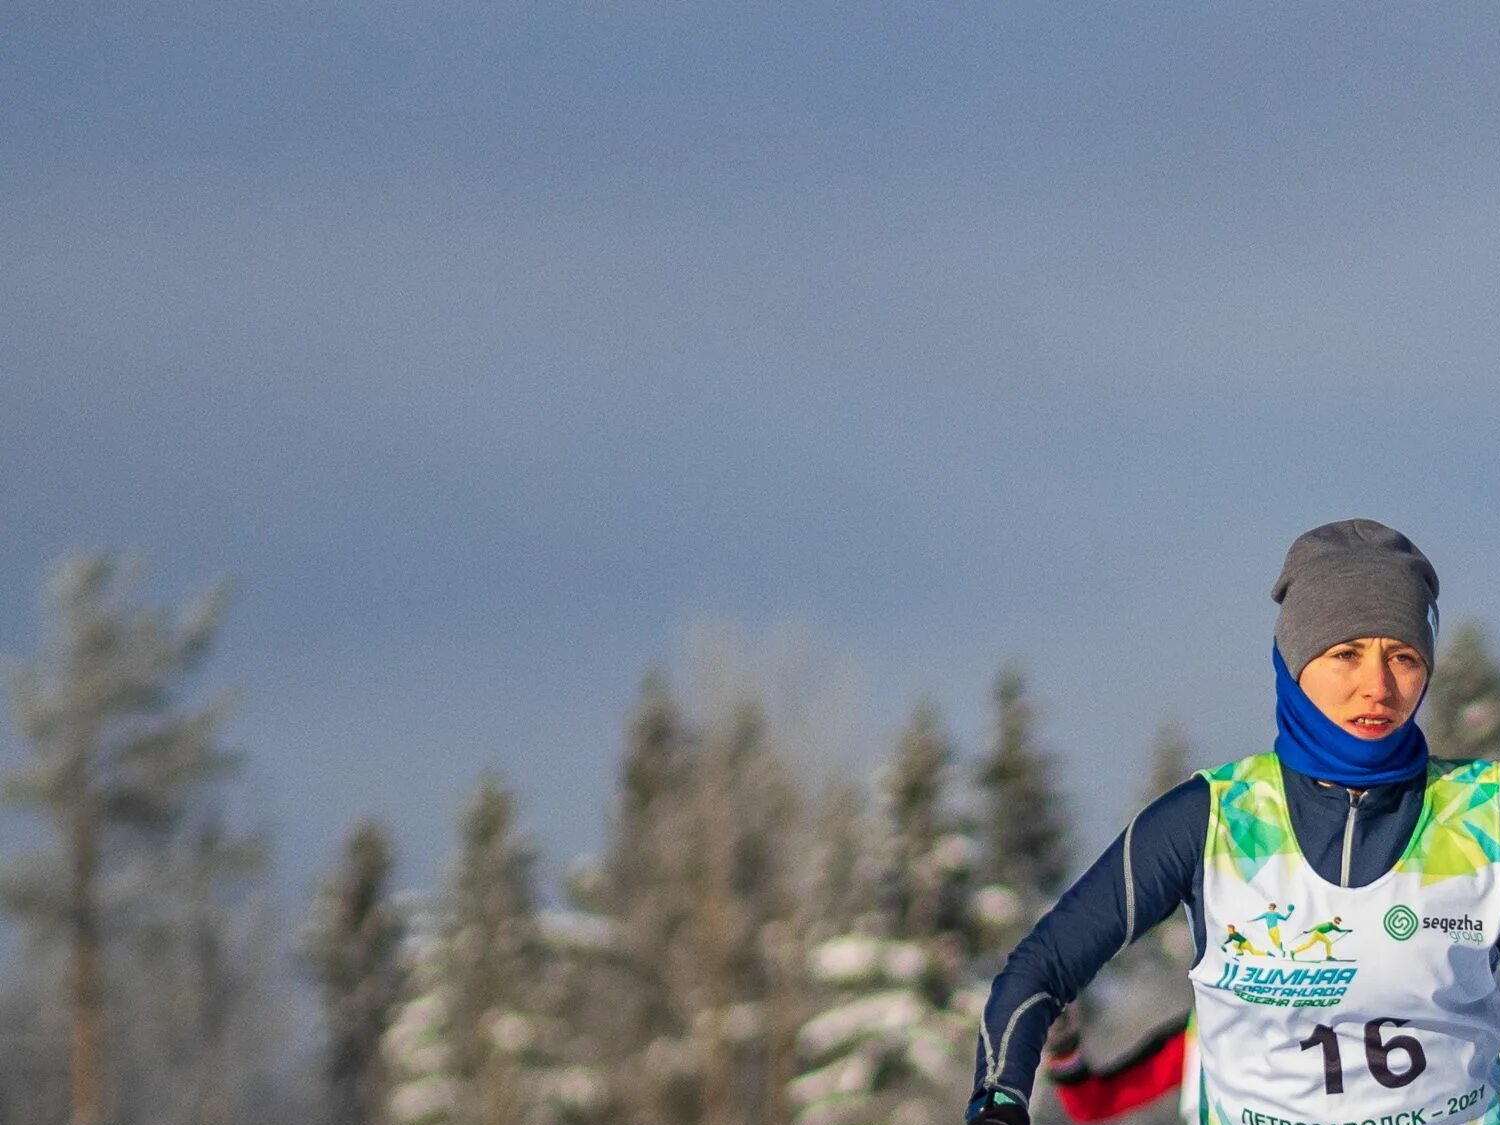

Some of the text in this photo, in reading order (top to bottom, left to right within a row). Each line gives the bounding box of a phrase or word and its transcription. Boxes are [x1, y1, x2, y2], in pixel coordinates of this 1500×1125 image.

[1422, 914, 1484, 933] segezha
[1449, 931, 1484, 945] group
[1292, 998, 1341, 1008] GROUP
[1300, 1017, 1427, 1095] 16
[1447, 1084, 1486, 1115] 2021
